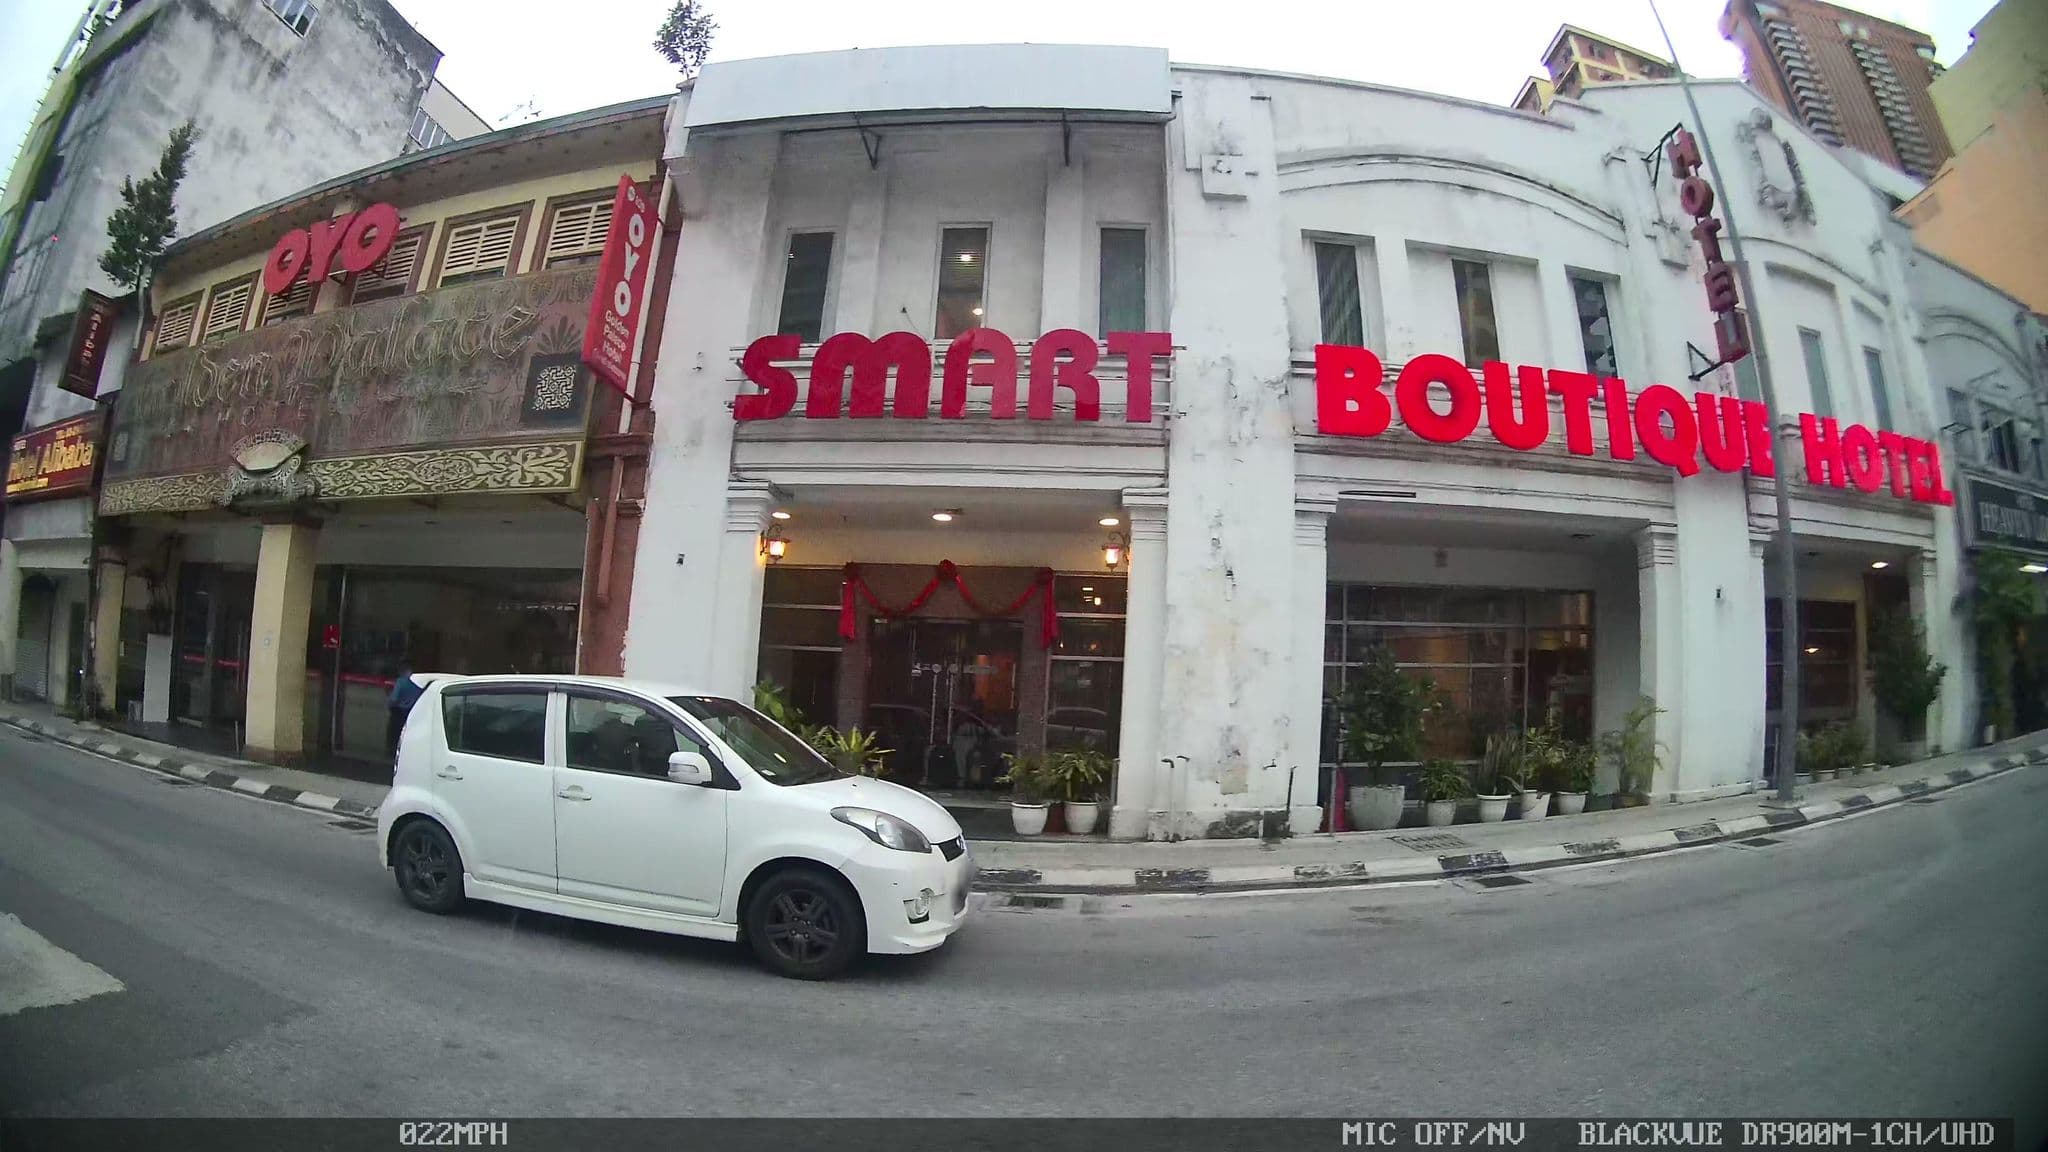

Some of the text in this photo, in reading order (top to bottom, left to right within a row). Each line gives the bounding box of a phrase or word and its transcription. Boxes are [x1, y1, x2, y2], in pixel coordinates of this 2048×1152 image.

[264, 202, 400, 295] OYO
[615, 213, 645, 317] OYO
[1666, 128, 1752, 363] HOTEL
[602, 340, 622, 364] Hotel
[603, 323, 627, 352] Palace
[605, 309, 629, 339] Golden
[733, 328, 1954, 507] SMART BOUTIQUE HOTEL
[38, 435, 94, 475] Alibaba
